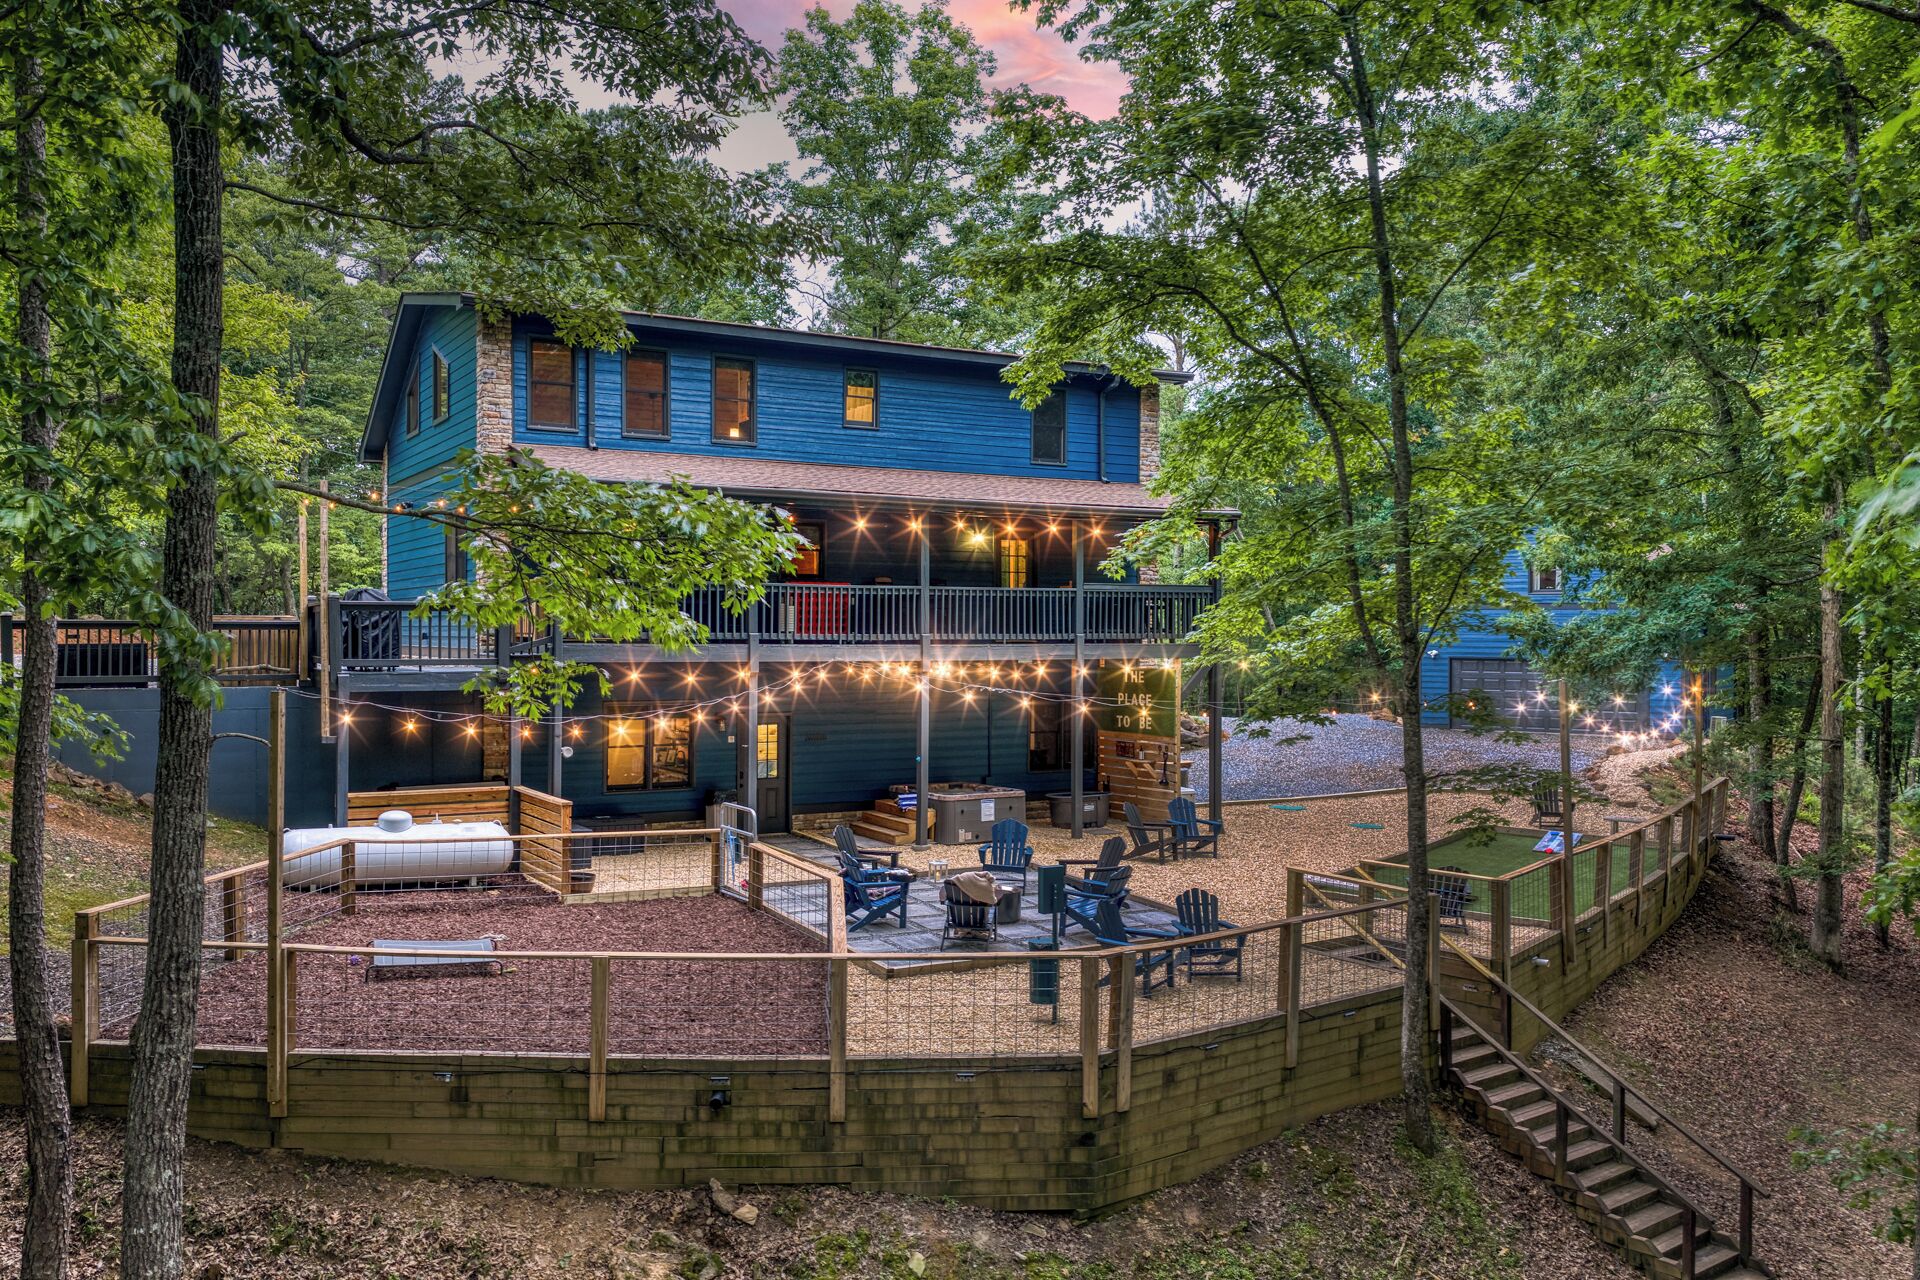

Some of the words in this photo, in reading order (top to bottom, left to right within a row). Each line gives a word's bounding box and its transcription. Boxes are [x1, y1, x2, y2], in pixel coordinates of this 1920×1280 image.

[1117, 692, 1152, 706] PLACE
[1116, 715, 1130, 728] TO
[1139, 716, 1152, 730] BE
